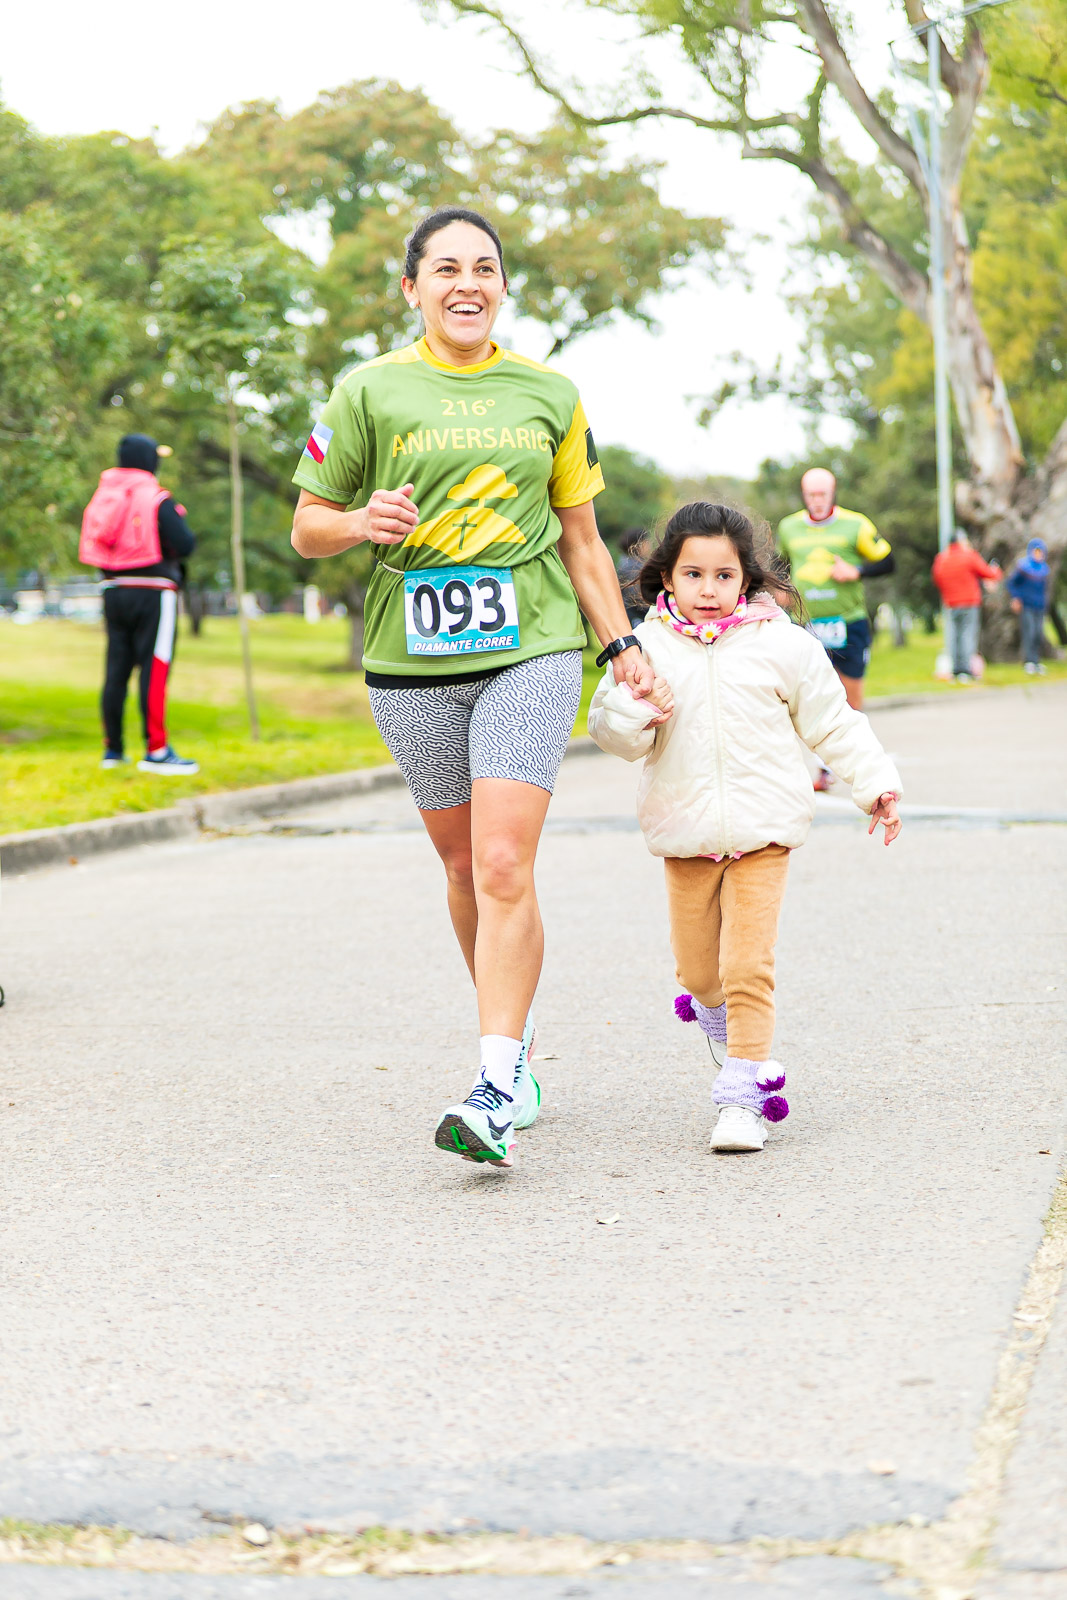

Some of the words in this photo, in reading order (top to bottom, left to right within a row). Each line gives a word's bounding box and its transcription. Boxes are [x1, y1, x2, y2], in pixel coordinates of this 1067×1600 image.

[392, 427, 550, 458] ANIVERSARIO
[412, 576, 506, 639] 093
[413, 639, 473, 653] DIAMANTE
[475, 635, 514, 649] CORRE
